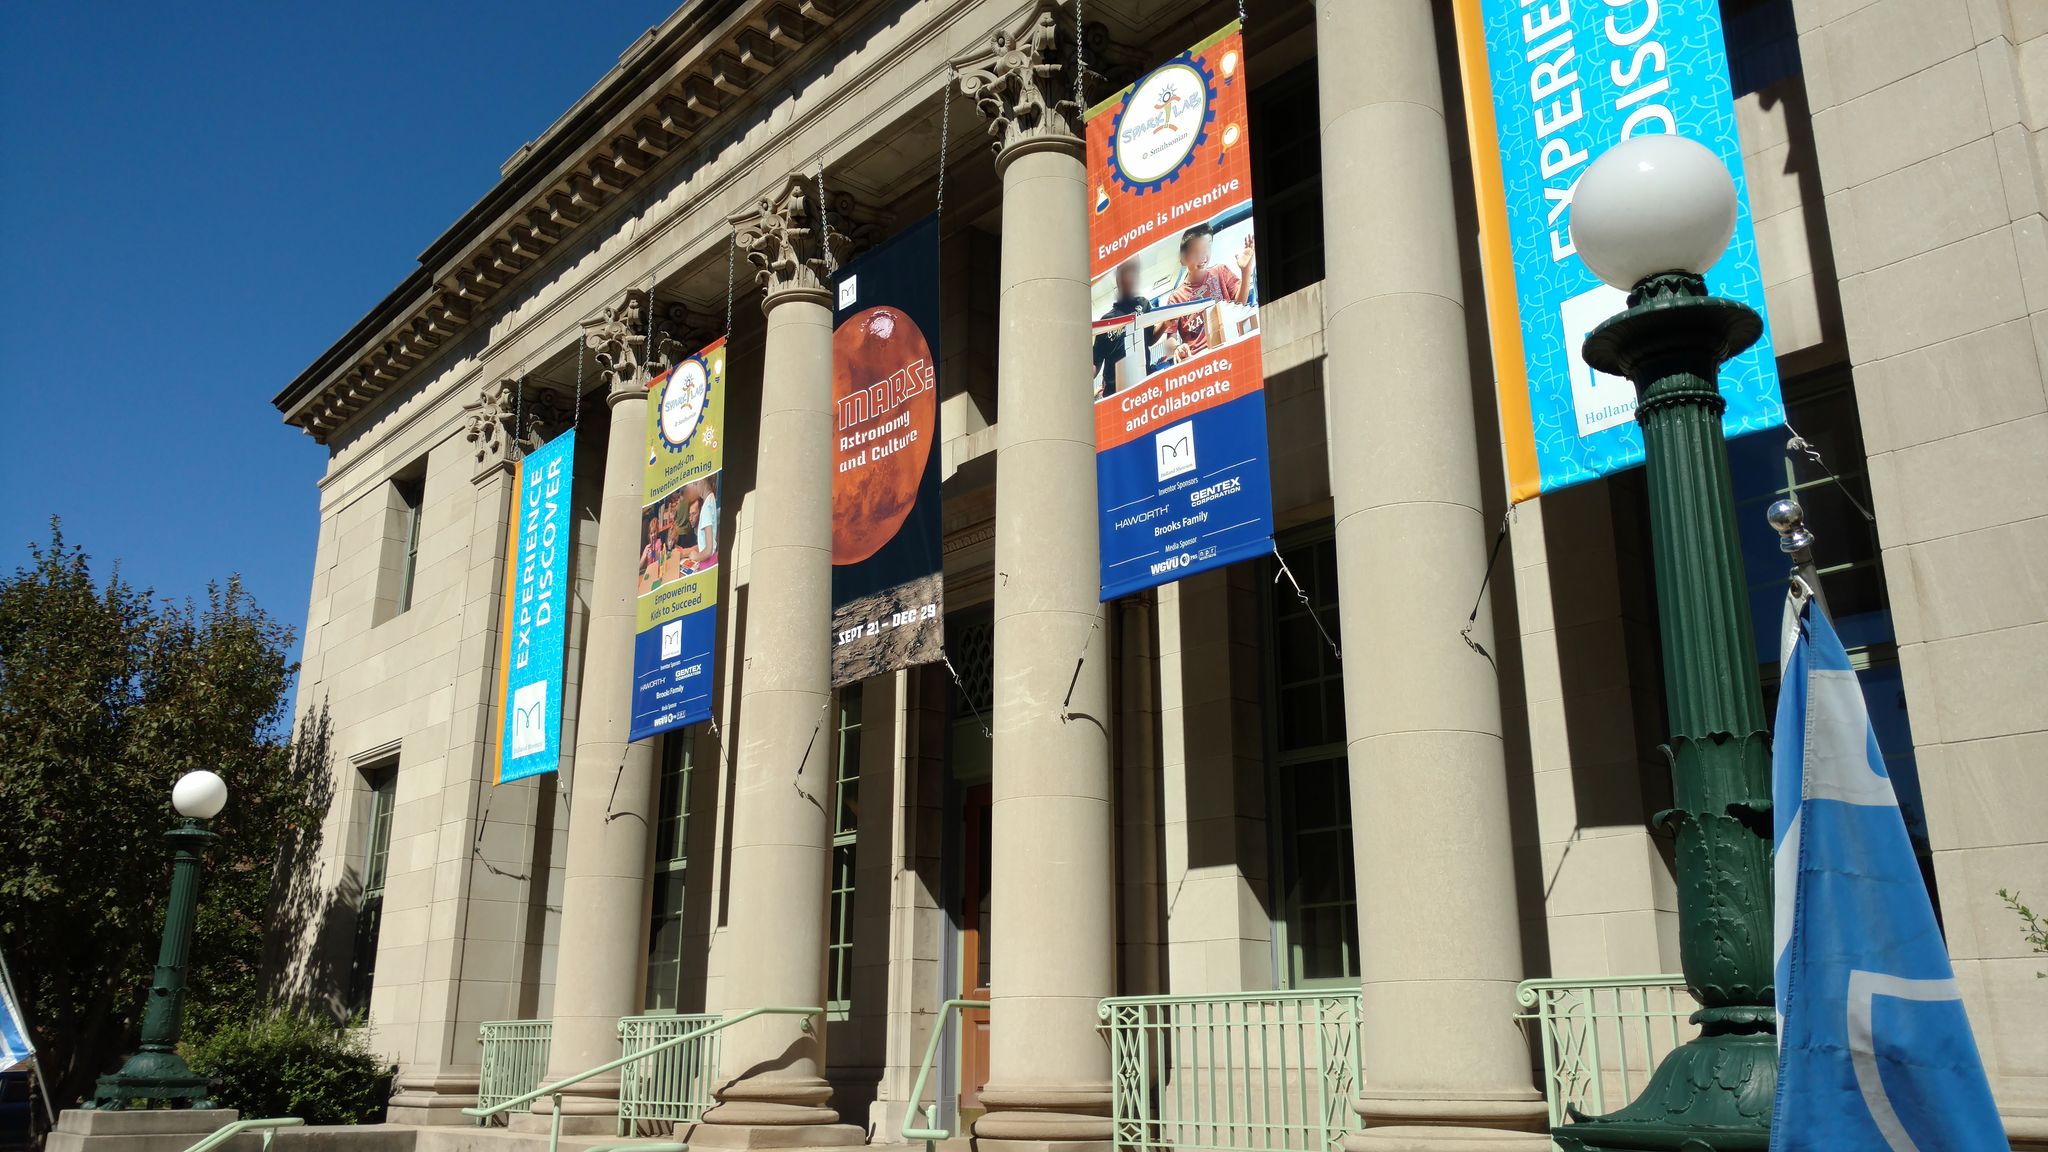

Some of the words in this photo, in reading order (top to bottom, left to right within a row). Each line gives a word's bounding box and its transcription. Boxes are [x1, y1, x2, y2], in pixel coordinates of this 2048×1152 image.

[1603, 0, 1678, 143] DISC
[1122, 109, 1164, 144] SPARK
[1172, 91, 1201, 117] LAB
[1520, 0, 1590, 263] EXPERIE
[1150, 131, 1188, 157] Smithsonian
[1098, 219, 1154, 260] Everyone
[1157, 212, 1168, 226] is
[1171, 178, 1239, 219] Inventive
[838, 359, 934, 431] MARS:
[1121, 386, 1163, 412] Create,
[1165, 356, 1233, 392] Innovate,
[1126, 409, 1149, 432] and
[1151, 379, 1230, 420] Collaborate
[1585, 398, 1638, 424] Holland
[840, 410, 910, 452] Astronomy
[664, 454, 694, 477] Hands-On
[840, 450, 866, 473] and
[871, 430, 918, 461] Culture
[650, 476, 679, 498] Invention
[680, 460, 712, 481] Learning
[1158, 484, 1177, 497] Inventor
[1176, 477, 1199, 491] Sponsors
[1190, 476, 1241, 502] GENTEX
[1191, 486, 1241, 507] CORPORATION
[535, 455, 563, 627] DISCOVER
[1154, 520, 1181, 537] Brooks
[1182, 510, 1209, 528] Family
[516, 466, 545, 670] EXPERIENCE
[1150, 558, 1179, 575] WGVU
[650, 609, 662, 621] Kids
[662, 606, 670, 616] to
[671, 593, 702, 613] Succeed
[655, 582, 698, 605] Empowering
[839, 625, 864, 646] SEPT
[866, 620, 880, 636] 21
[892, 609, 917, 628] DEC
[920, 603, 936, 621] 29
[675, 663, 702, 677] GENTEX
